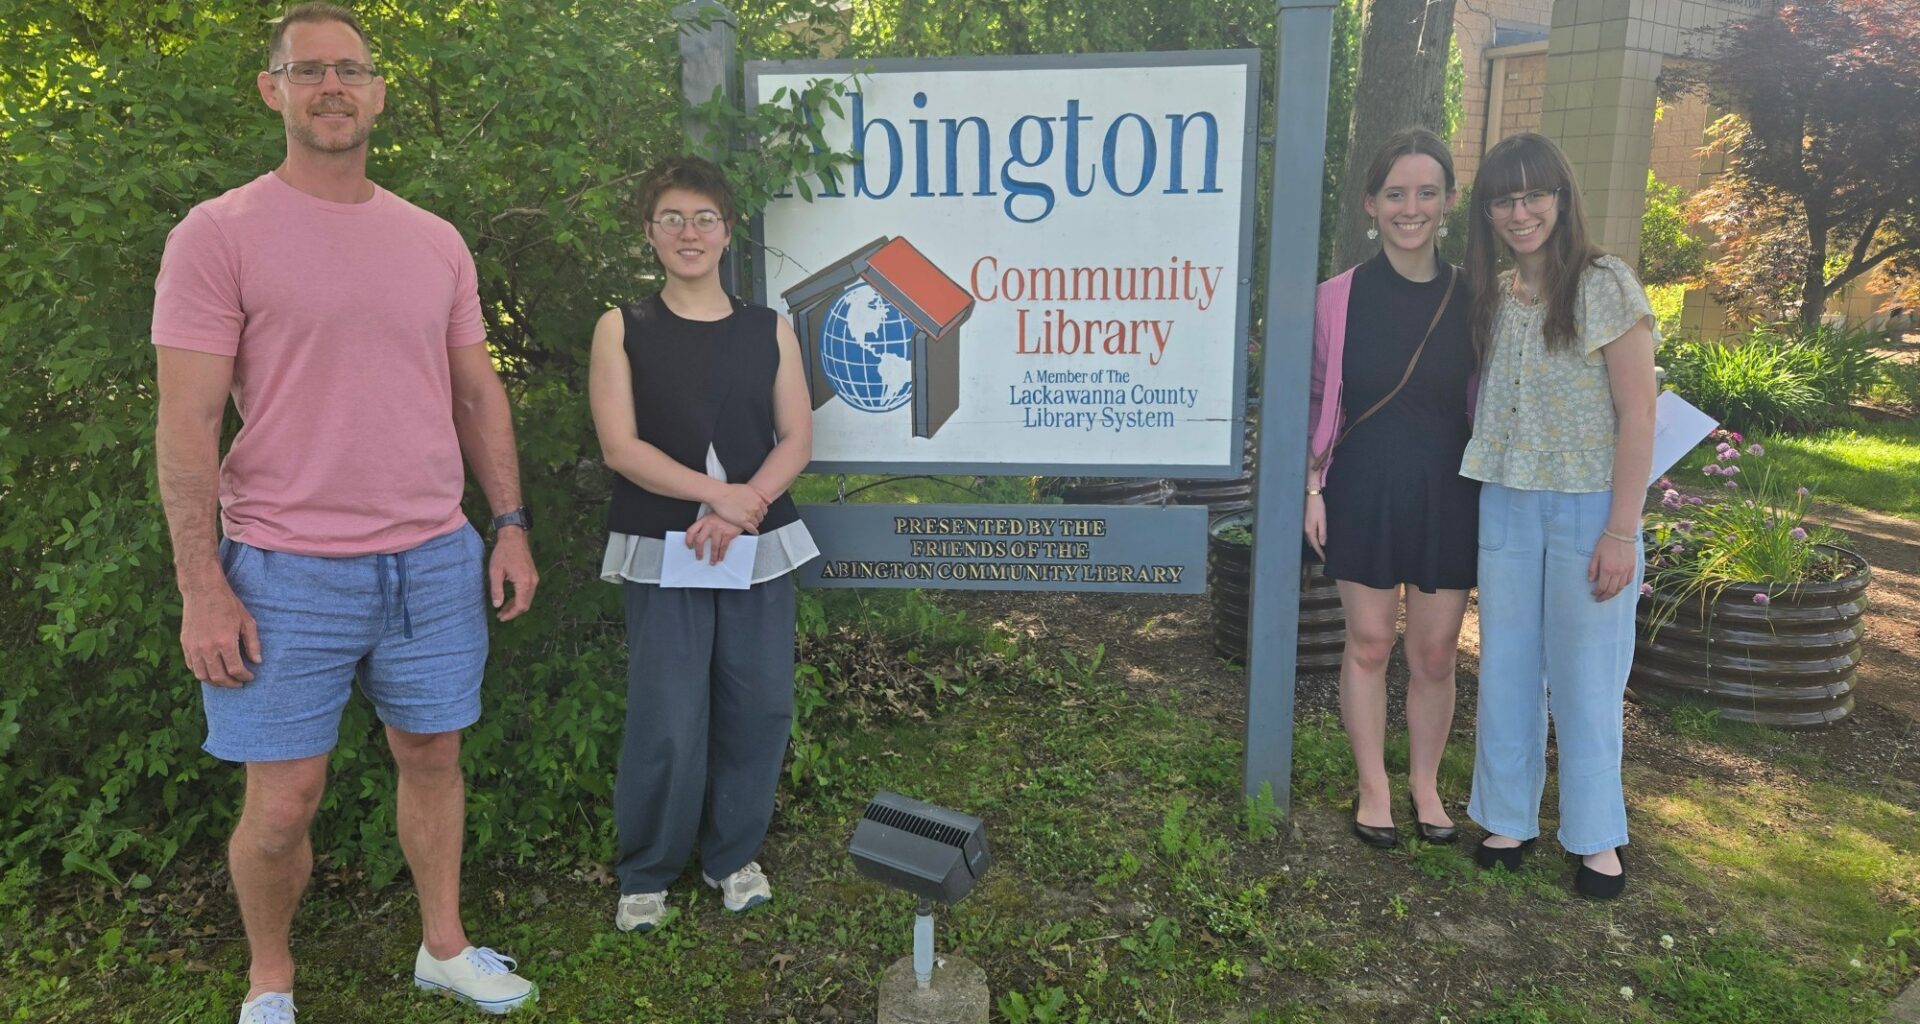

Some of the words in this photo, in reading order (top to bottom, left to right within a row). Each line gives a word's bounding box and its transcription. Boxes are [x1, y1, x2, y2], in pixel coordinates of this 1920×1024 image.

[970, 255, 1223, 311] Community
[1016, 309, 1174, 366] Library
[1023, 370, 1033, 384] A
[1036, 369, 1088, 384] Member
[1090, 369, 1104, 384] of
[1106, 369, 1130, 384] The
[1009, 385, 1126, 406] Lackawanna
[1131, 384, 1198, 408] County
[1024, 407, 1097, 432] Library
[1101, 406, 1175, 432] System
[894, 516, 1025, 536] PRESENTED
[1027, 518, 1057, 536] BY
[1059, 519, 1106, 537] THE
[910, 539, 1008, 558] FRIENDS
[1010, 540, 1040, 558] OF
[1042, 541, 1090, 559] THE
[820, 560, 935, 579] ABINGTON
[936, 561, 1079, 582] COMMUNITY
[1081, 563, 1185, 583] LIBRARY
